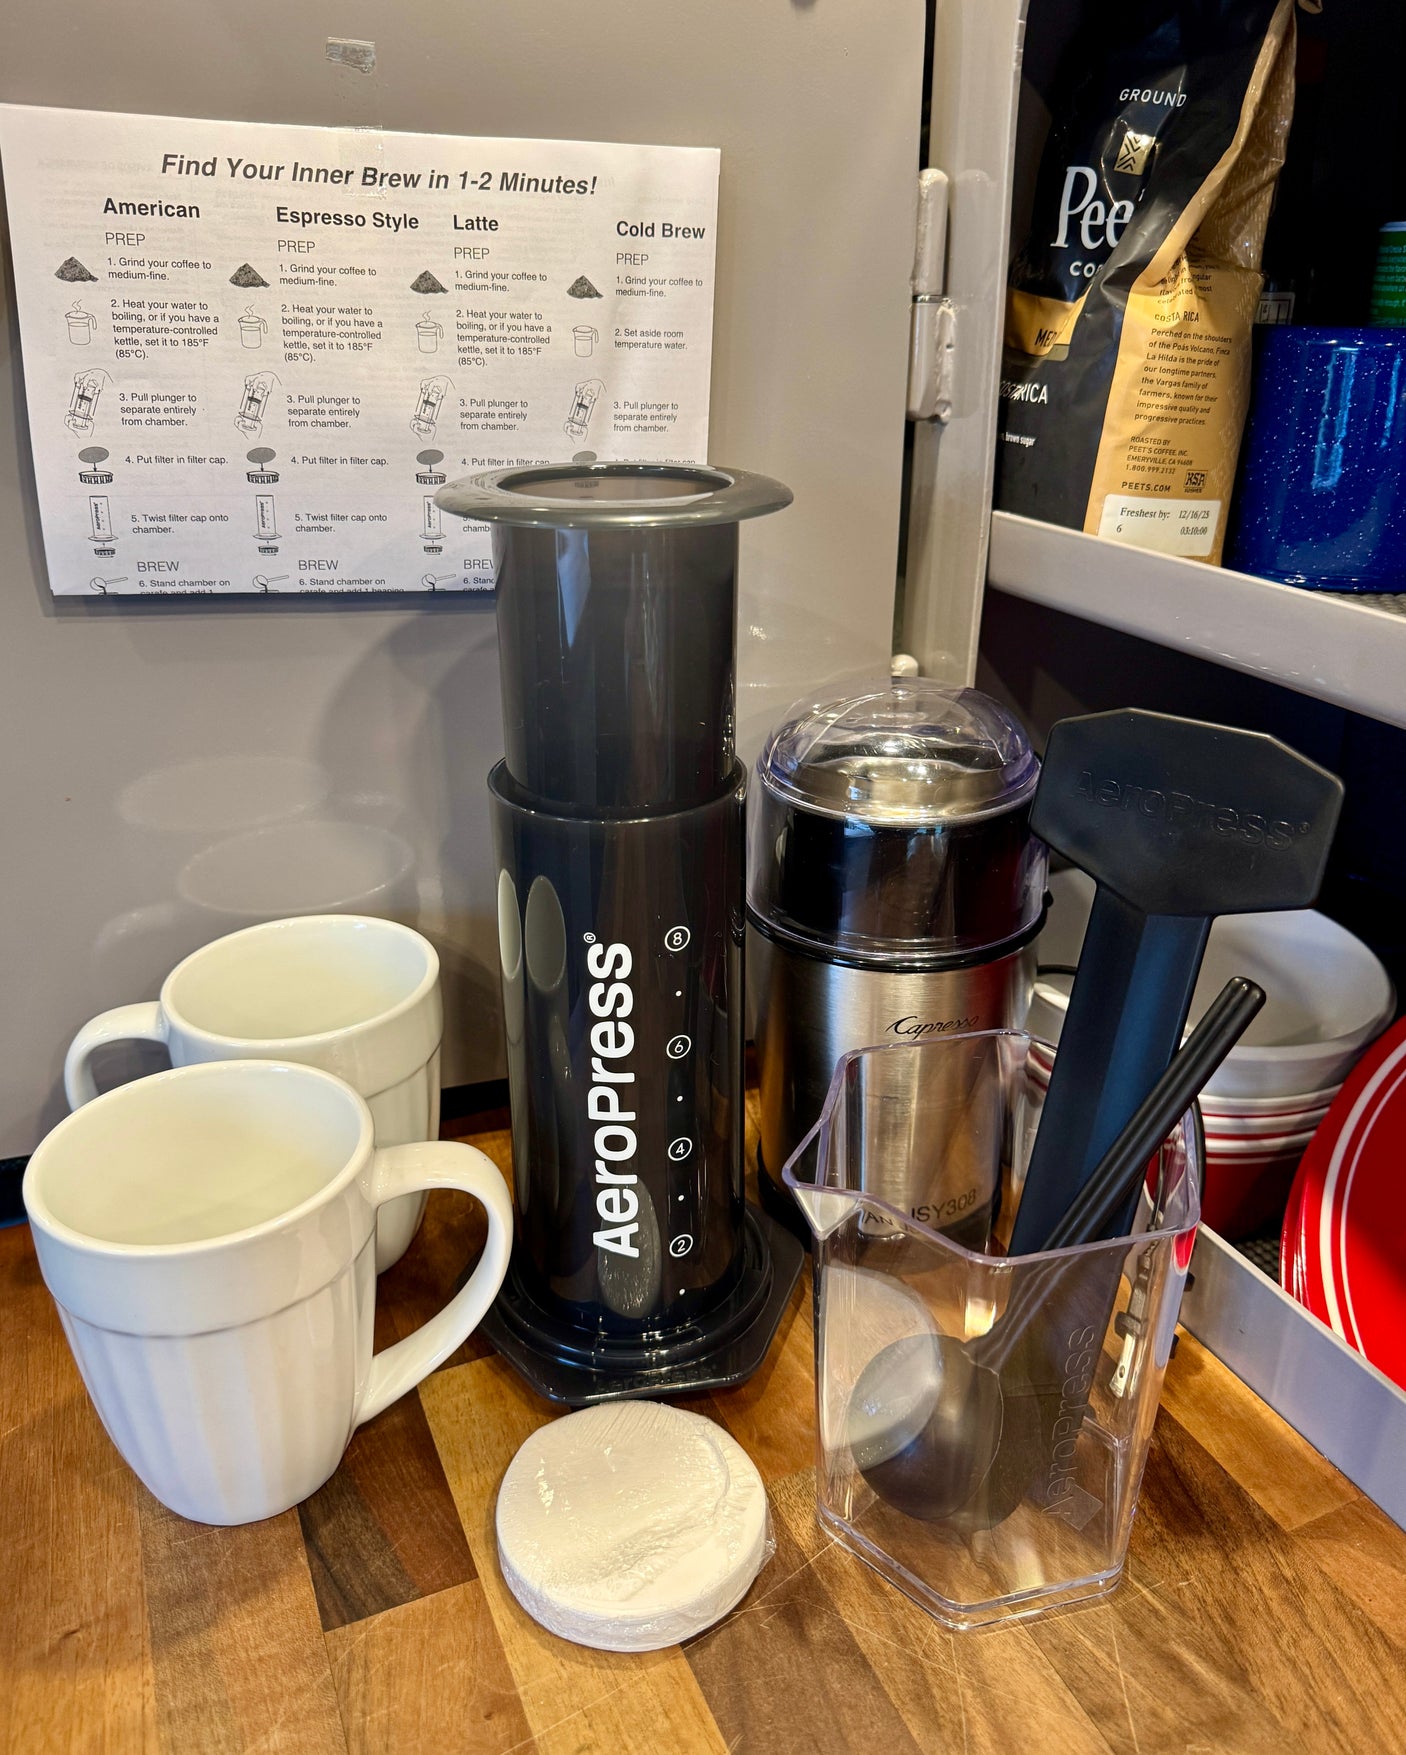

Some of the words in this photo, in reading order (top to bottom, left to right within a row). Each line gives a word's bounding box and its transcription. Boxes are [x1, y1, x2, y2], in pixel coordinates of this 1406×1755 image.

[1119, 88, 1187, 107] GROUND
[161, 153, 217, 176] Find
[226, 157, 285, 180] Your
[291, 161, 354, 184] Inner
[361, 166, 422, 188] Brew
[428, 169, 449, 189] in
[459, 170, 492, 190] 1-2
[499, 172, 597, 195] Minutes!
[103, 197, 200, 218] American
[1050, 166, 1134, 250] Pee
[276, 206, 366, 228] Espresso
[372, 211, 419, 232] Style
[453, 214, 499, 231] Latte
[616, 220, 654, 237] Cold
[662, 222, 705, 239] Brew
[105, 232, 145, 246] PREP
[277, 239, 315, 253] PREP
[453, 246, 490, 260] PREP
[616, 252, 648, 265] PREP
[107, 257, 116, 266] 1.
[118, 256, 145, 267] Grind
[147, 260, 168, 269] your
[170, 259, 200, 269] coffee
[202, 260, 211, 269] to
[108, 270, 169, 280] medium-fine.
[279, 276, 337, 286] medium-fine.
[454, 282, 509, 292] medium-fine.
[615, 287, 666, 297] medium-fine.
[110, 298, 120, 307] 2.
[122, 298, 145, 308] Heat
[147, 301, 168, 311] your
[170, 301, 197, 310] water
[198, 302, 208, 310] to
[111, 311, 145, 323] boiling,
[160, 312, 166, 321] if
[168, 314, 185, 324] you
[187, 313, 211, 322] have
[1154, 312, 1180, 322] COSTA
[1183, 311, 1199, 322] RICA
[112, 324, 218, 335] temperature-controlled
[282, 328, 381, 339] temperature-controlled
[614, 328, 622, 336] 2.
[624, 328, 638, 337] Set
[639, 329, 661, 337] aside
[456, 333, 550, 344] temperature-controlled
[1151, 328, 1182, 338] Perched
[1204, 334, 1232, 343] shoulders
[114, 336, 142, 346] kettle,
[145, 338, 159, 346] set
[161, 337, 167, 346] it
[169, 338, 179, 346] to
[182, 338, 209, 347] 185°F
[614, 340, 662, 350] temperature
[1158, 341, 1170, 349] the
[115, 349, 148, 360] (85°C).
[1146, 352, 1156, 360] La
[1157, 353, 1178, 362] Hilda
[1159, 366, 1190, 376] longtime
[1141, 376, 1154, 385] the
[1156, 378, 1181, 388] Vargas
[1181, 380, 1201, 390] family
[119, 392, 128, 401] 3.
[130, 392, 148, 401] Pull
[150, 393, 186, 404] plunger
[187, 394, 197, 402] to
[1020, 382, 1047, 404] RICA
[120, 405, 161, 415] separate
[163, 405, 196, 416] entirely
[287, 407, 326, 417] separate
[328, 407, 360, 418] entirely
[1136, 400, 1178, 412] impressive
[1178, 405, 1199, 414] quality
[459, 411, 496, 420] separate
[497, 410, 527, 421] entirely
[613, 413, 648, 422] separate
[649, 413, 677, 423] entirely
[1134, 414, 1177, 423] progressive
[121, 417, 143, 426] from
[144, 417, 187, 426] chamber.
[1131, 436, 1162, 445] ROASTED
[125, 455, 134, 463] 4.
[136, 455, 152, 463] Put
[154, 455, 174, 464] filter
[176, 455, 185, 463] in
[187, 455, 206, 464] filter
[208, 457, 228, 466] cap.
[1121, 482, 1170, 492] PEETS.COM
[131, 514, 140, 522] 5.
[141, 514, 166, 522] Twist
[168, 514, 188, 522] filter
[190, 515, 207, 523] cap
[1120, 507, 1156, 518] Freshest
[1158, 509, 1170, 520] by:
[1179, 510, 1210, 520] 12/16/25
[132, 525, 174, 534] chamber.
[1116, 524, 1122, 532] 6
[136, 561, 179, 572] BREW
[298, 559, 338, 570] BREW
[149, 579, 176, 587] Stand
[886, 1016, 979, 1040] Capresso
